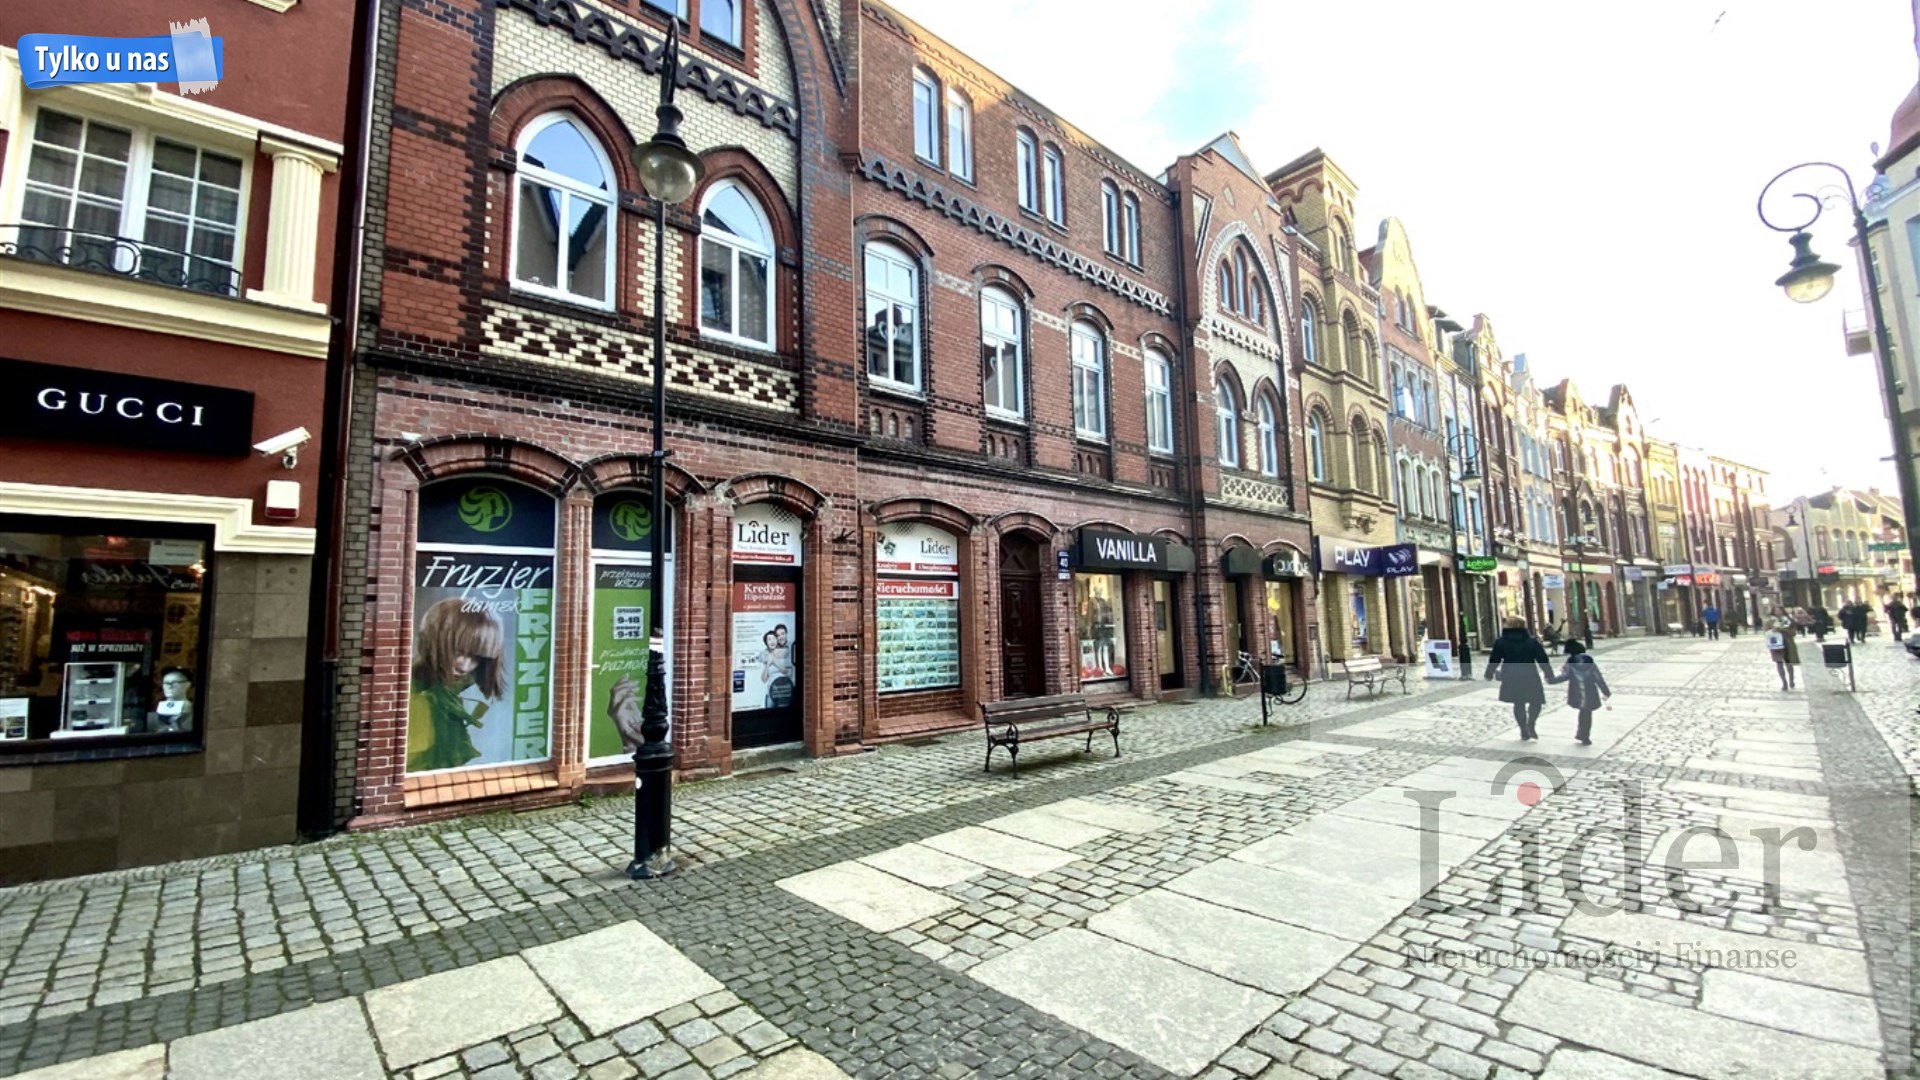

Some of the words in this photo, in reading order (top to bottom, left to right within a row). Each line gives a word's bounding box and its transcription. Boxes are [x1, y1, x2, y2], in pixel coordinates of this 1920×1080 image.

[37, 387, 204, 426] GUCCI
[737, 520, 790, 545] Lider
[920, 538, 951, 555] Lider
[1096, 537, 1157, 563] VANILLA
[1334, 545, 1370, 567] PLAY
[421, 555, 550, 599] Fryzjer
[1386, 565, 1415, 574] PLAY
[744, 583, 786, 594] Kredyty
[88, 644, 96, 652] W
[98, 643, 145, 653] SPRZEDAŻY
[514, 588, 549, 760] FRYZJER
